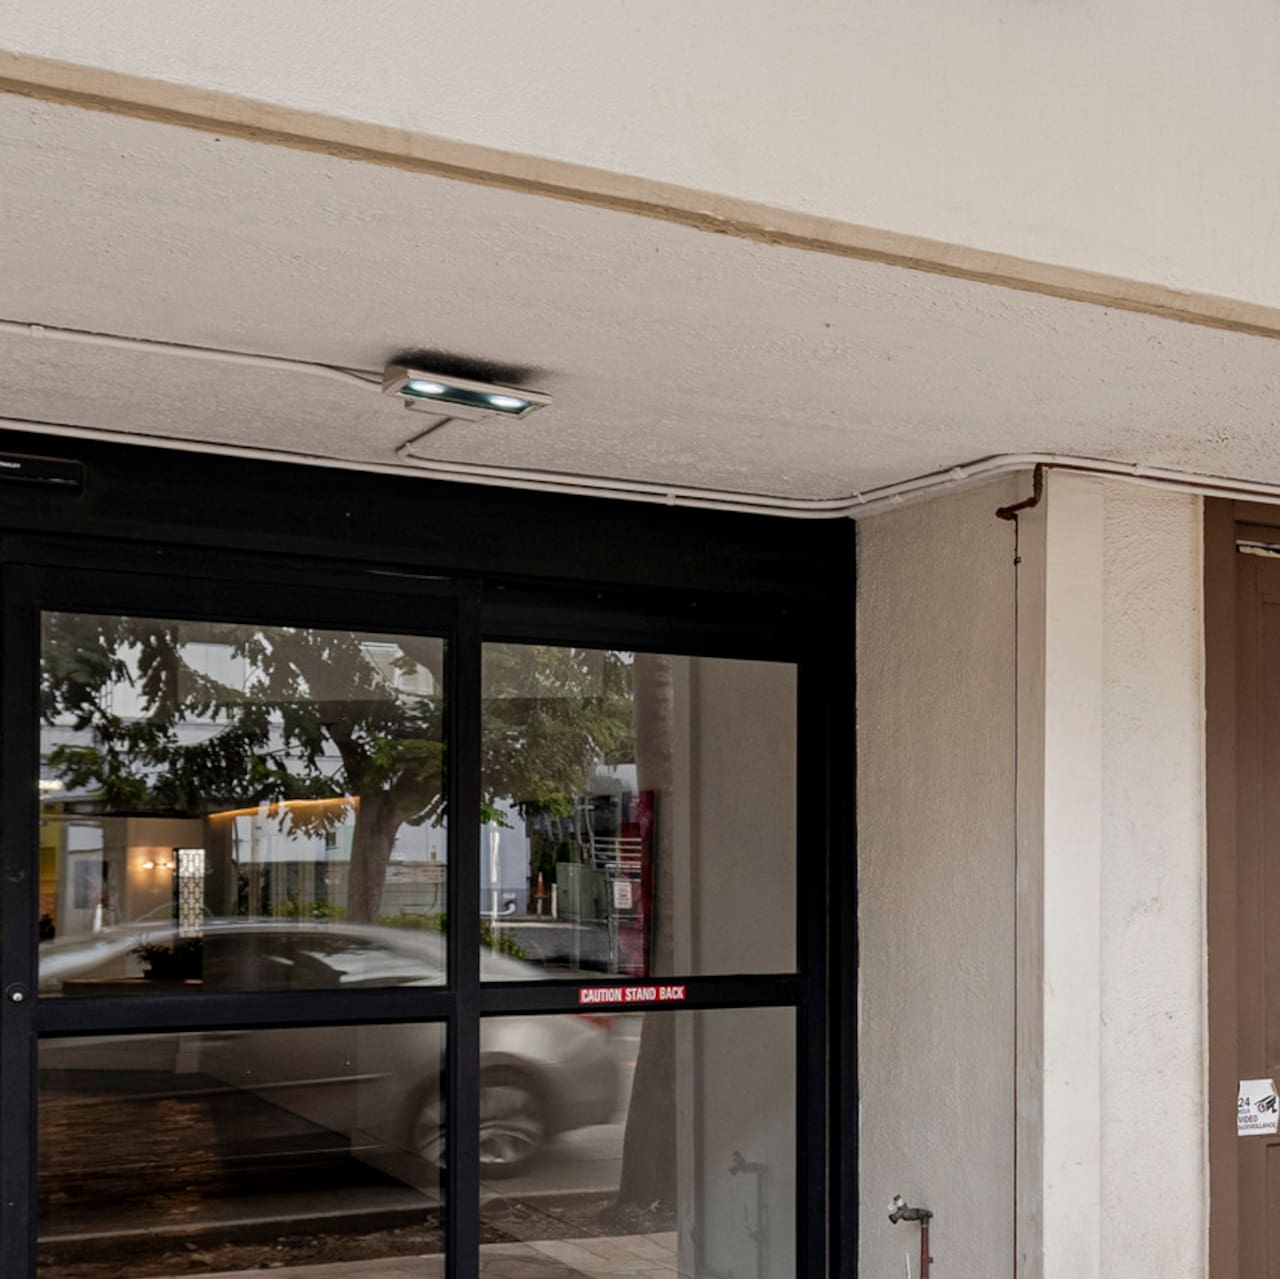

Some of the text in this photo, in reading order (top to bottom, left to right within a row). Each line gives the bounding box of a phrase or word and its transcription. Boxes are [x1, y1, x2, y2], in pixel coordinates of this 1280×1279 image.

[580, 985, 685, 1003] CAUTION STAND BACK
